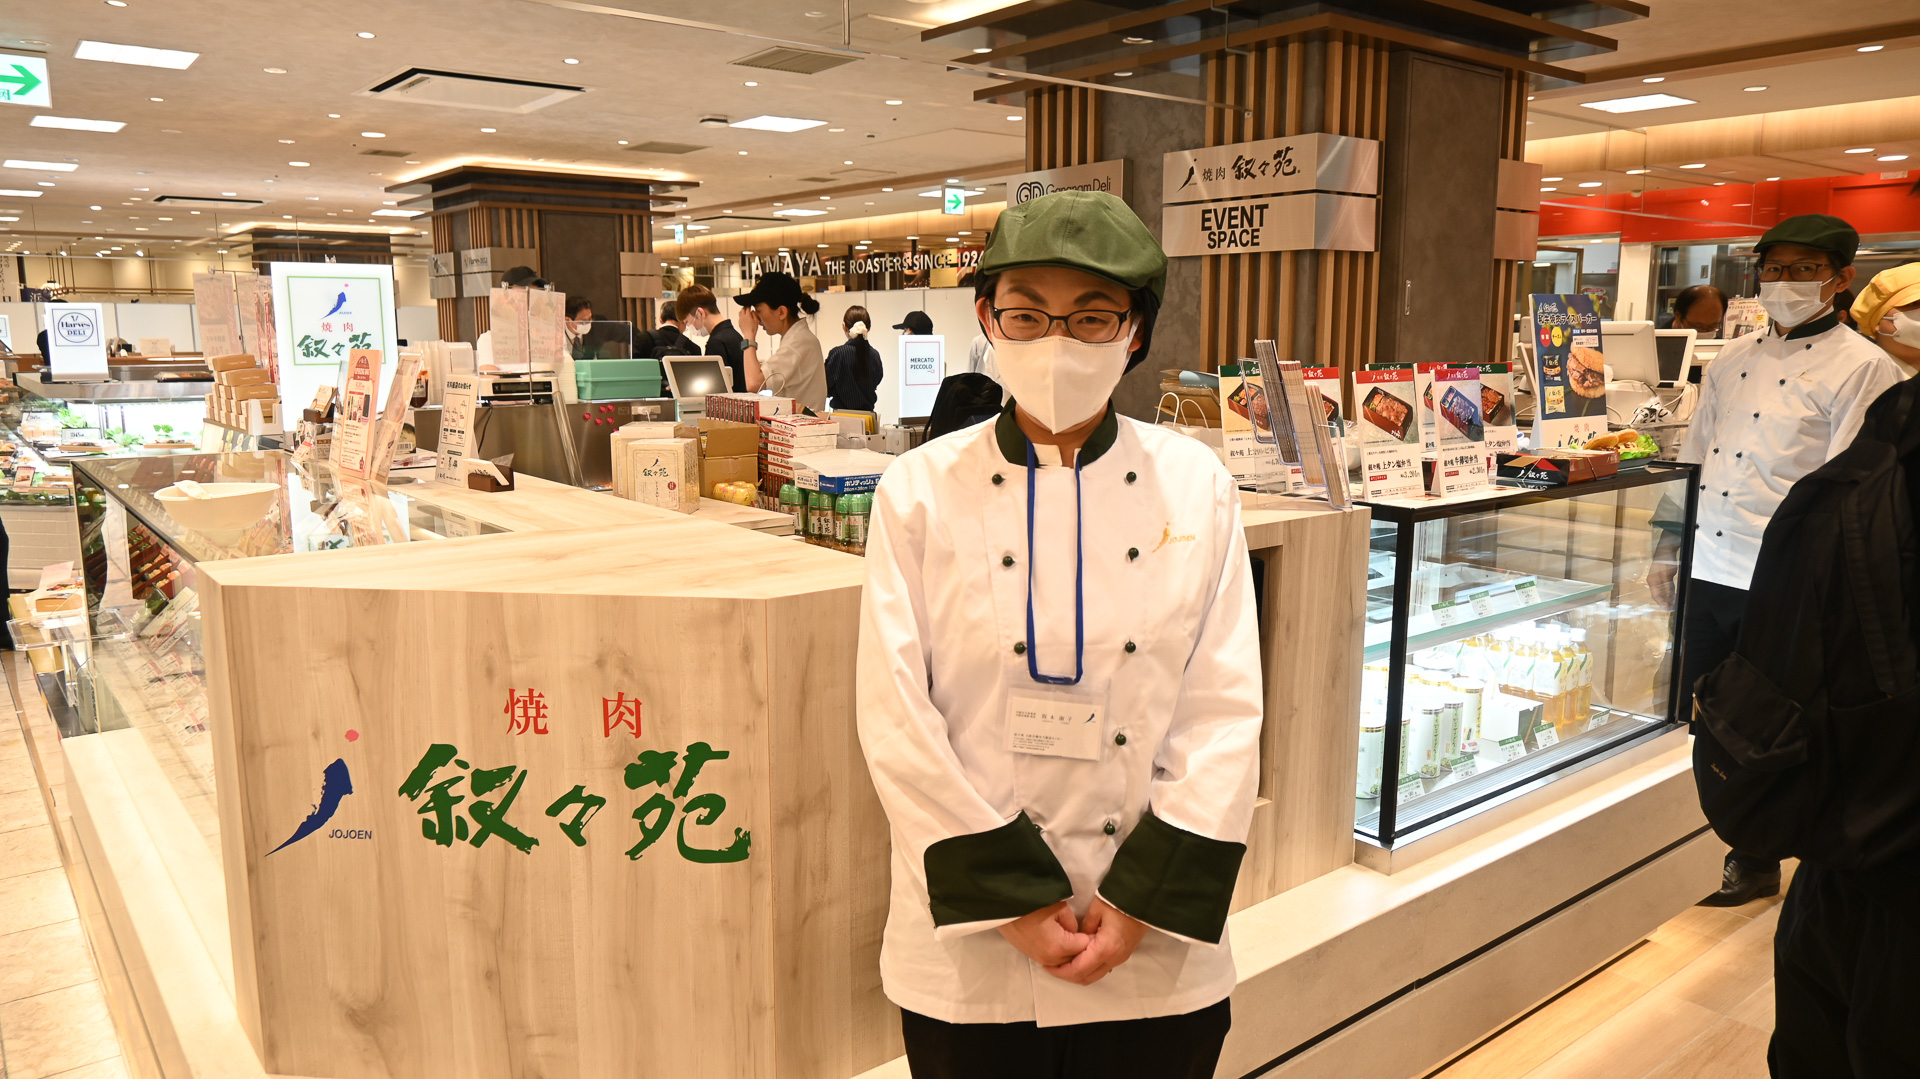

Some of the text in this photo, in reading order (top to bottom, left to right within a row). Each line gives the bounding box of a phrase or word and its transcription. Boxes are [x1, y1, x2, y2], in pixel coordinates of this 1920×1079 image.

[1202, 146, 1297, 183] 焼肉 叙々苑
[1093, 176, 1111, 192] Deli
[1201, 203, 1269, 231] EVENT
[1207, 229, 1260, 249] SPACE
[740, 251, 822, 280] HAMAYA
[825, 260, 846, 275] THE
[849, 255, 908, 274] ROASTERS
[912, 253, 951, 271] SINCE
[321, 322, 353, 333] 焼肉
[1168, 534, 1196, 544] JOJOEN
[503, 688, 643, 739] 焼肉
[398, 741, 752, 864] 叙々苑
[328, 828, 373, 840] JOJOEN
